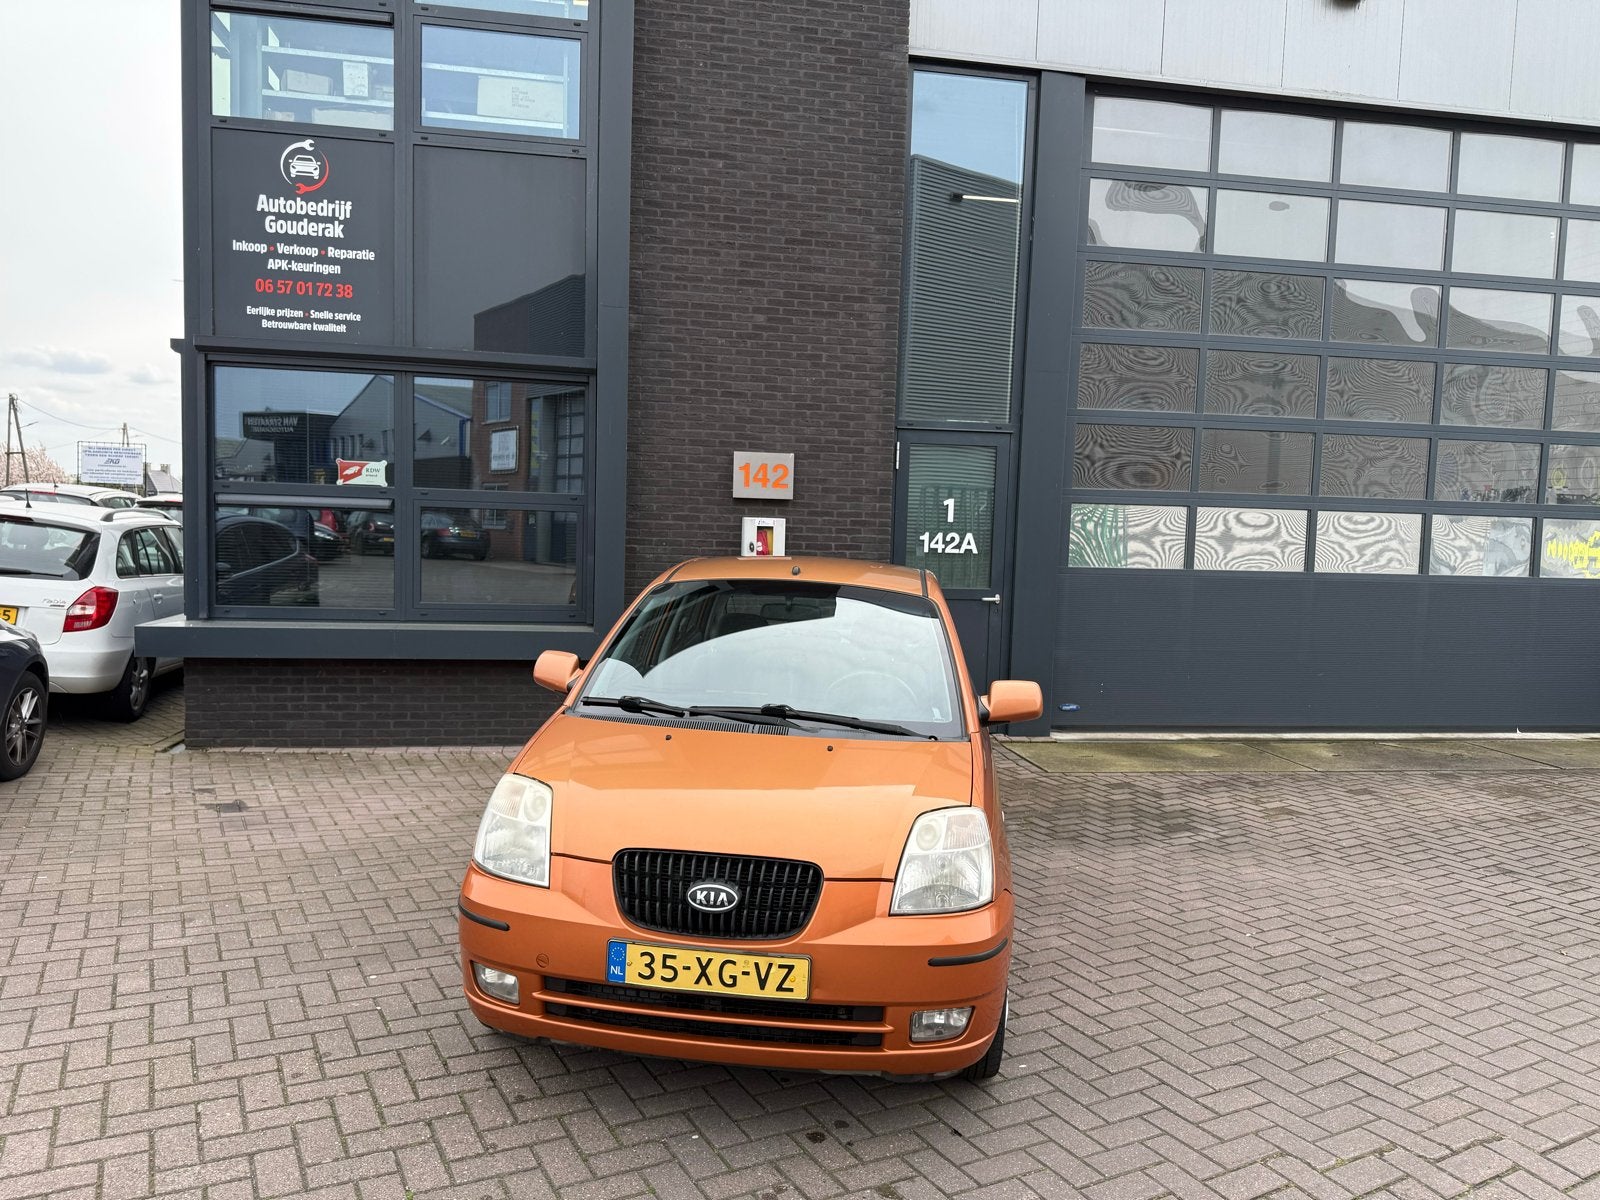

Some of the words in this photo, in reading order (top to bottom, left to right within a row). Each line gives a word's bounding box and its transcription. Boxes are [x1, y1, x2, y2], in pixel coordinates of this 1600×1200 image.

[257, 193, 352, 220] Autobedrijf
[265, 215, 344, 238] Gouderak
[232, 240, 267, 254] Inkoop
[277, 243, 318, 257] Verkoop
[328, 247, 375, 261] Reparatie
[268, 259, 341, 275] APK-keuringen
[255, 278, 274, 293] 06
[277, 280, 293, 294] 57
[296, 281, 313, 296] 01
[316, 282, 333, 297] 72
[336, 284, 353, 298] 38
[247, 306, 275, 317] Eerlijke
[277, 308, 304, 318] prijzen
[310, 310, 333, 320] Snelle
[335, 312, 361, 321] service
[262, 319, 312, 331] Betrouwbare
[313, 323, 347, 333] kwaliteit
[738, 462, 789, 489] 142
[943, 498, 955, 523] 1
[919, 531, 979, 555] 142A
[696, 890, 729, 906] KIA
[610, 965, 624, 976] NL
[637, 951, 796, 993] 35-XG-VZ
